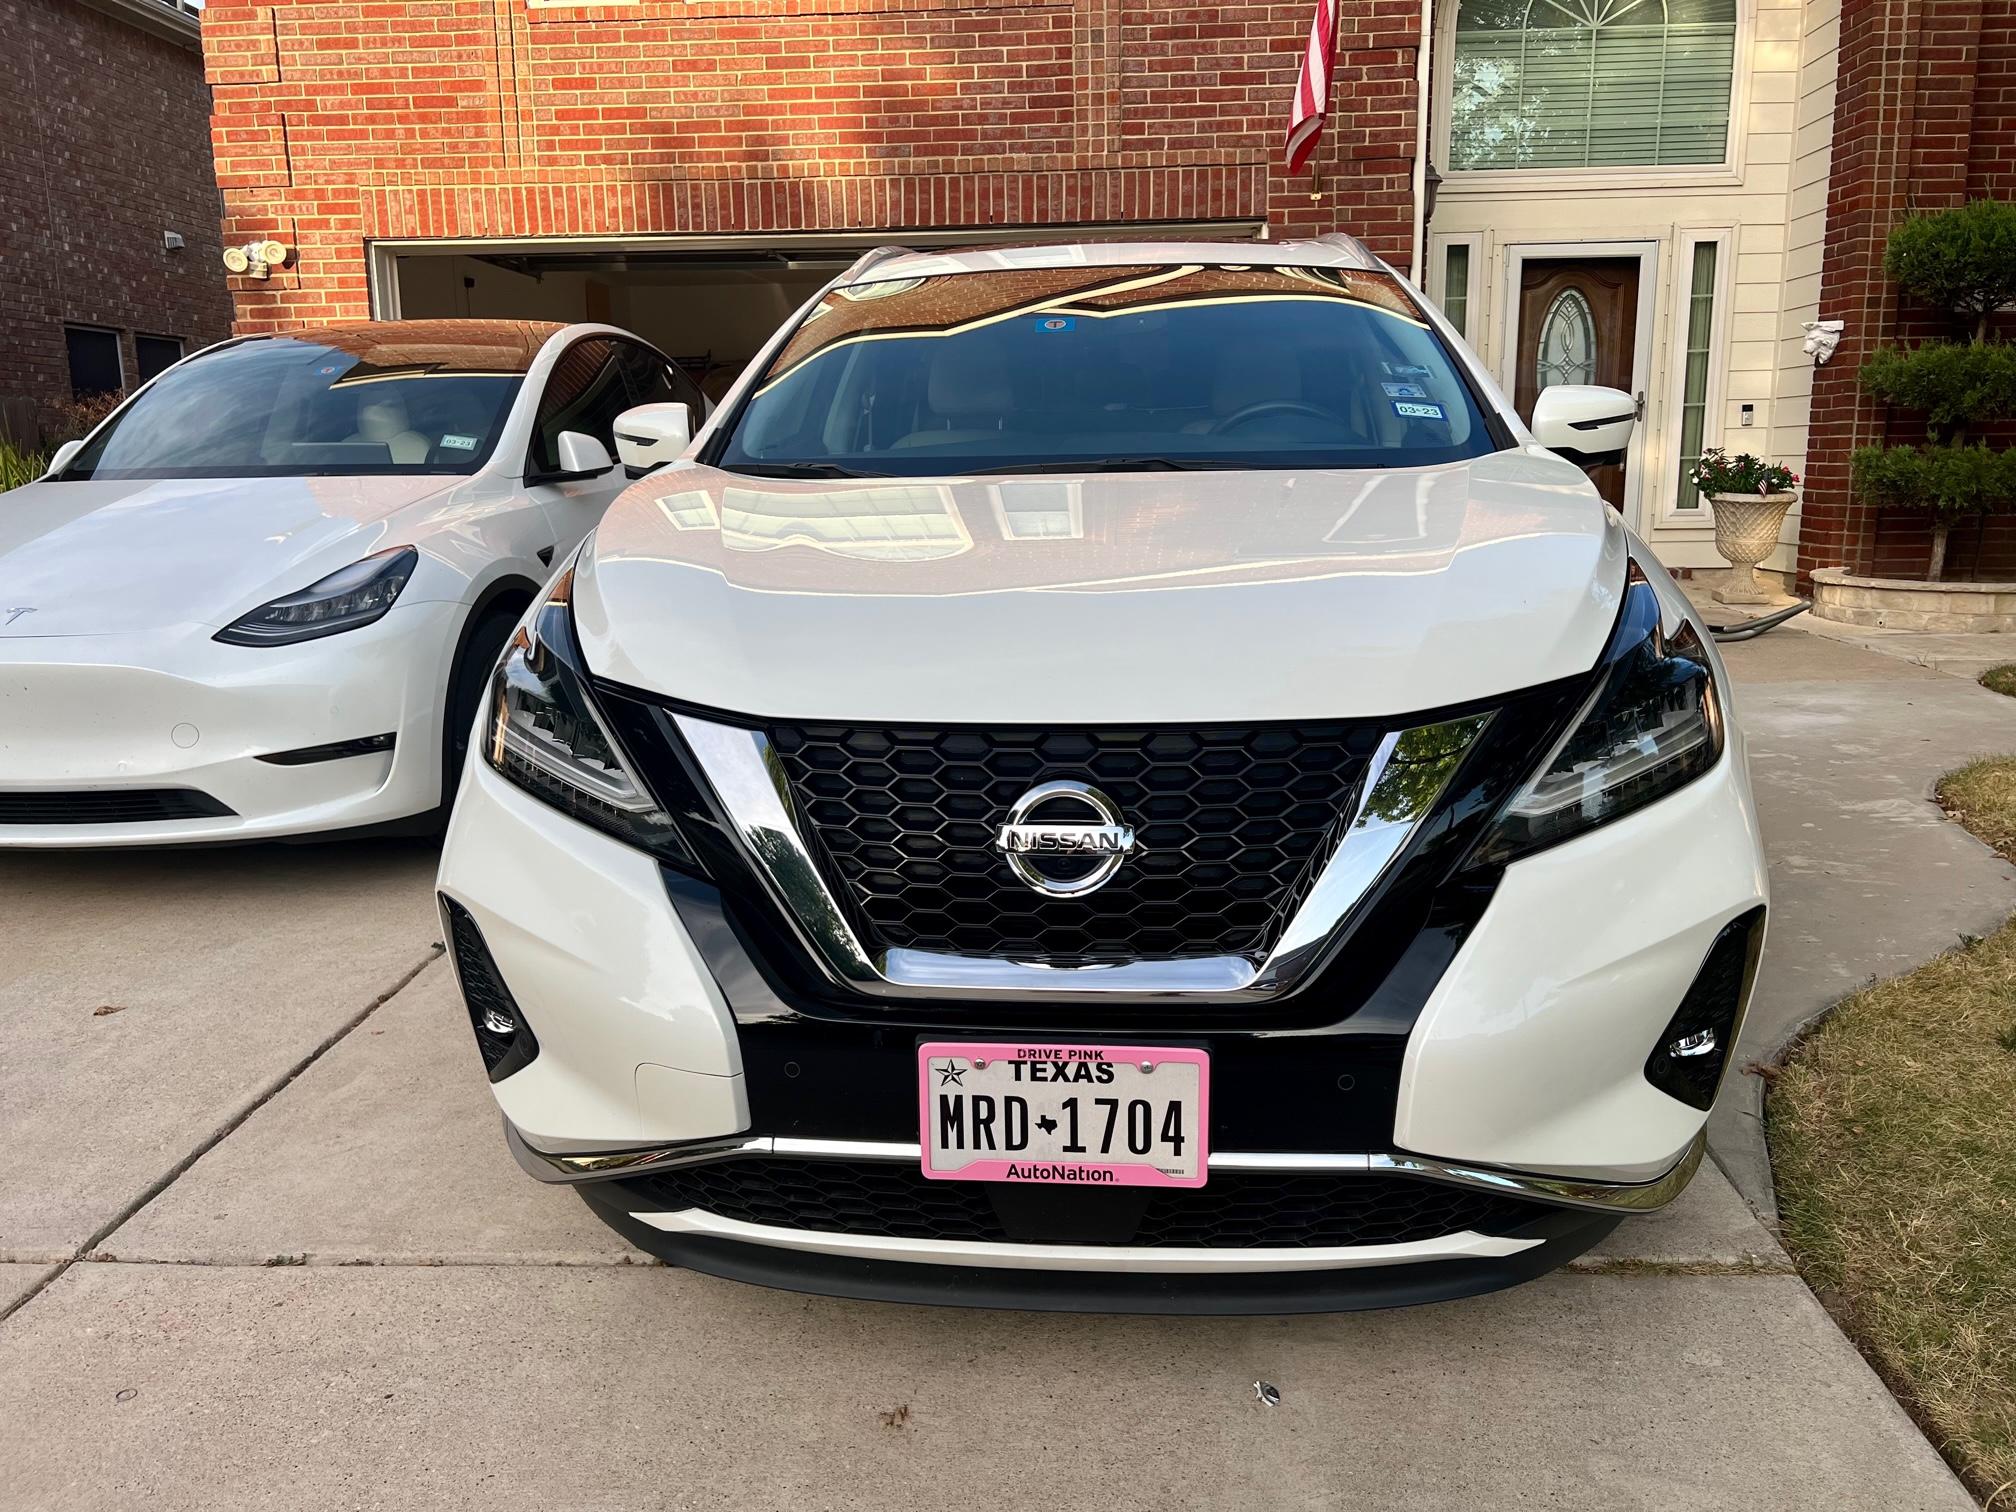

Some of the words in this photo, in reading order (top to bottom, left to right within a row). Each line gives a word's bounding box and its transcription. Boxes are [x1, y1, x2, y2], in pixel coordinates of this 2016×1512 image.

[1399, 405, 1439, 415] 03-23
[1009, 830, 1119, 850] NISSAN
[1017, 1048, 1064, 1060] DRIVE
[1067, 1049, 1105, 1061] PINK
[1008, 1060, 1115, 1084] TEXAS
[1006, 1163, 1114, 1182] AutoNation
